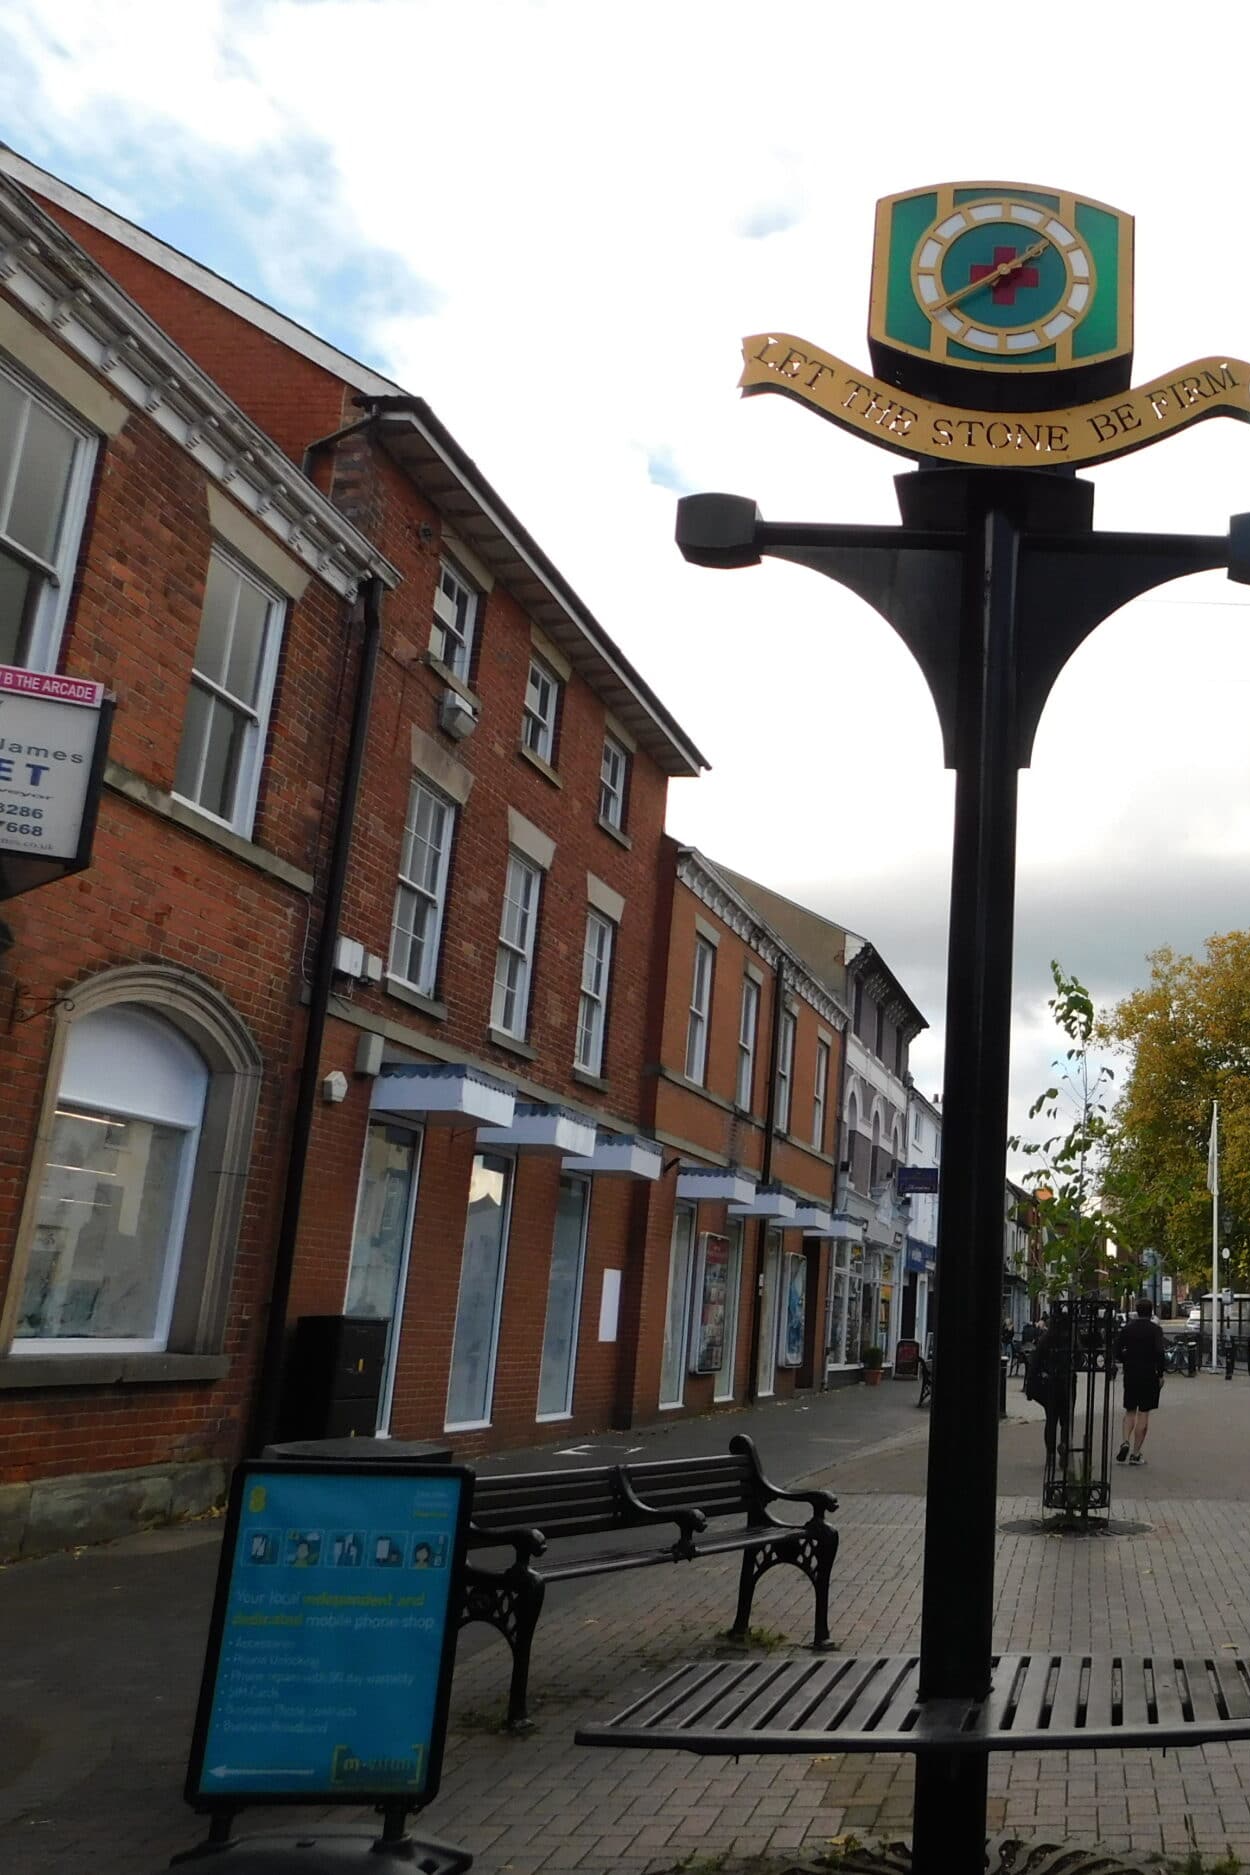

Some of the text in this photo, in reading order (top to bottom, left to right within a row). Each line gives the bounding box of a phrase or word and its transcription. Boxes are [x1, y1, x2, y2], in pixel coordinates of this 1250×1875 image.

[753, 336, 1240, 452] LET THE STONE BE FIRM
[16, 674, 40, 690] THE
[41, 680, 94, 700] ARCADE
[237, 1591, 266, 1605] Your
[269, 1590, 301, 1606] local
[397, 1592, 426, 1607] and
[305, 1611, 352, 1627] mobile
[354, 1613, 399, 1631] phone
[401, 1614, 436, 1632] shop
